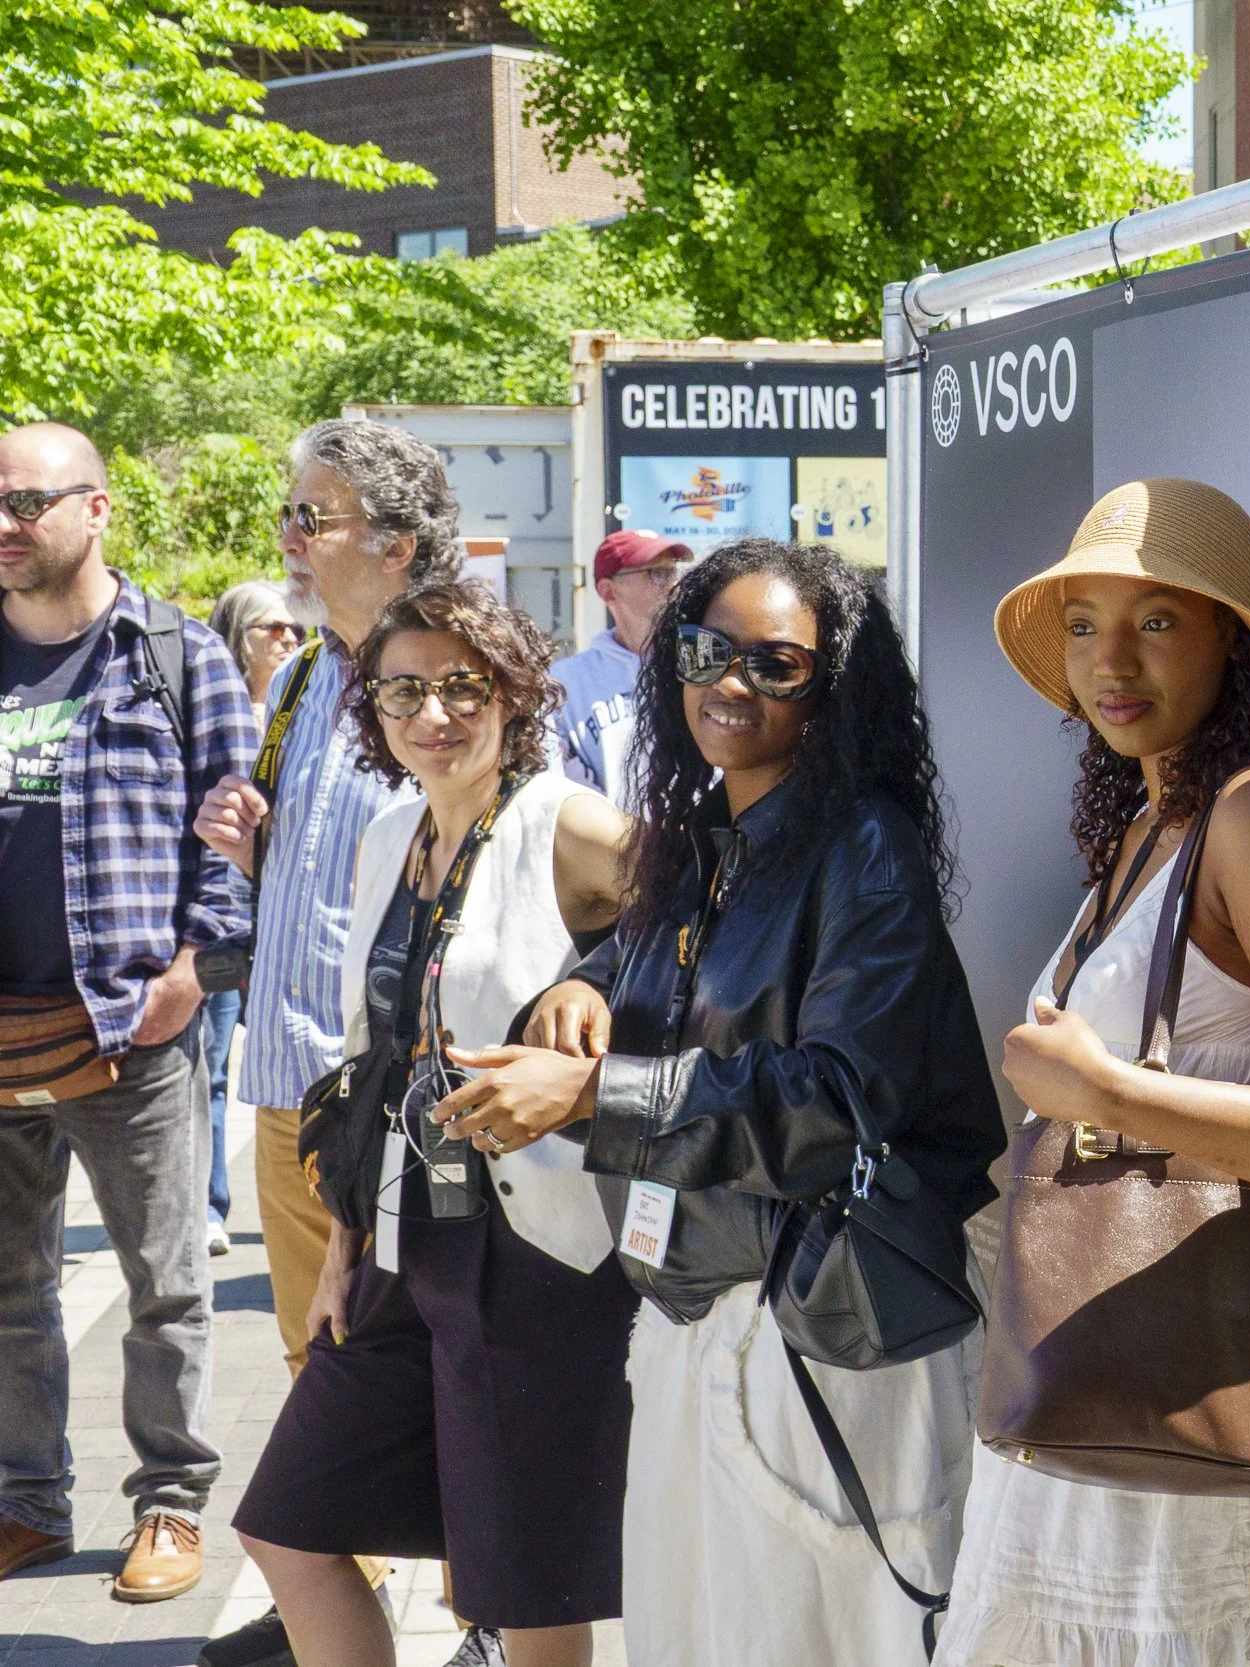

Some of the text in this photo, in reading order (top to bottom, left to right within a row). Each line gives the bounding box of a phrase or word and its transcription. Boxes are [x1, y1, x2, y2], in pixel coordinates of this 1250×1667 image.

[622, 385, 857, 430] CELEBRATING
[970, 337, 1077, 436] VSCO
[628, 1229, 658, 1258] ARTIST
